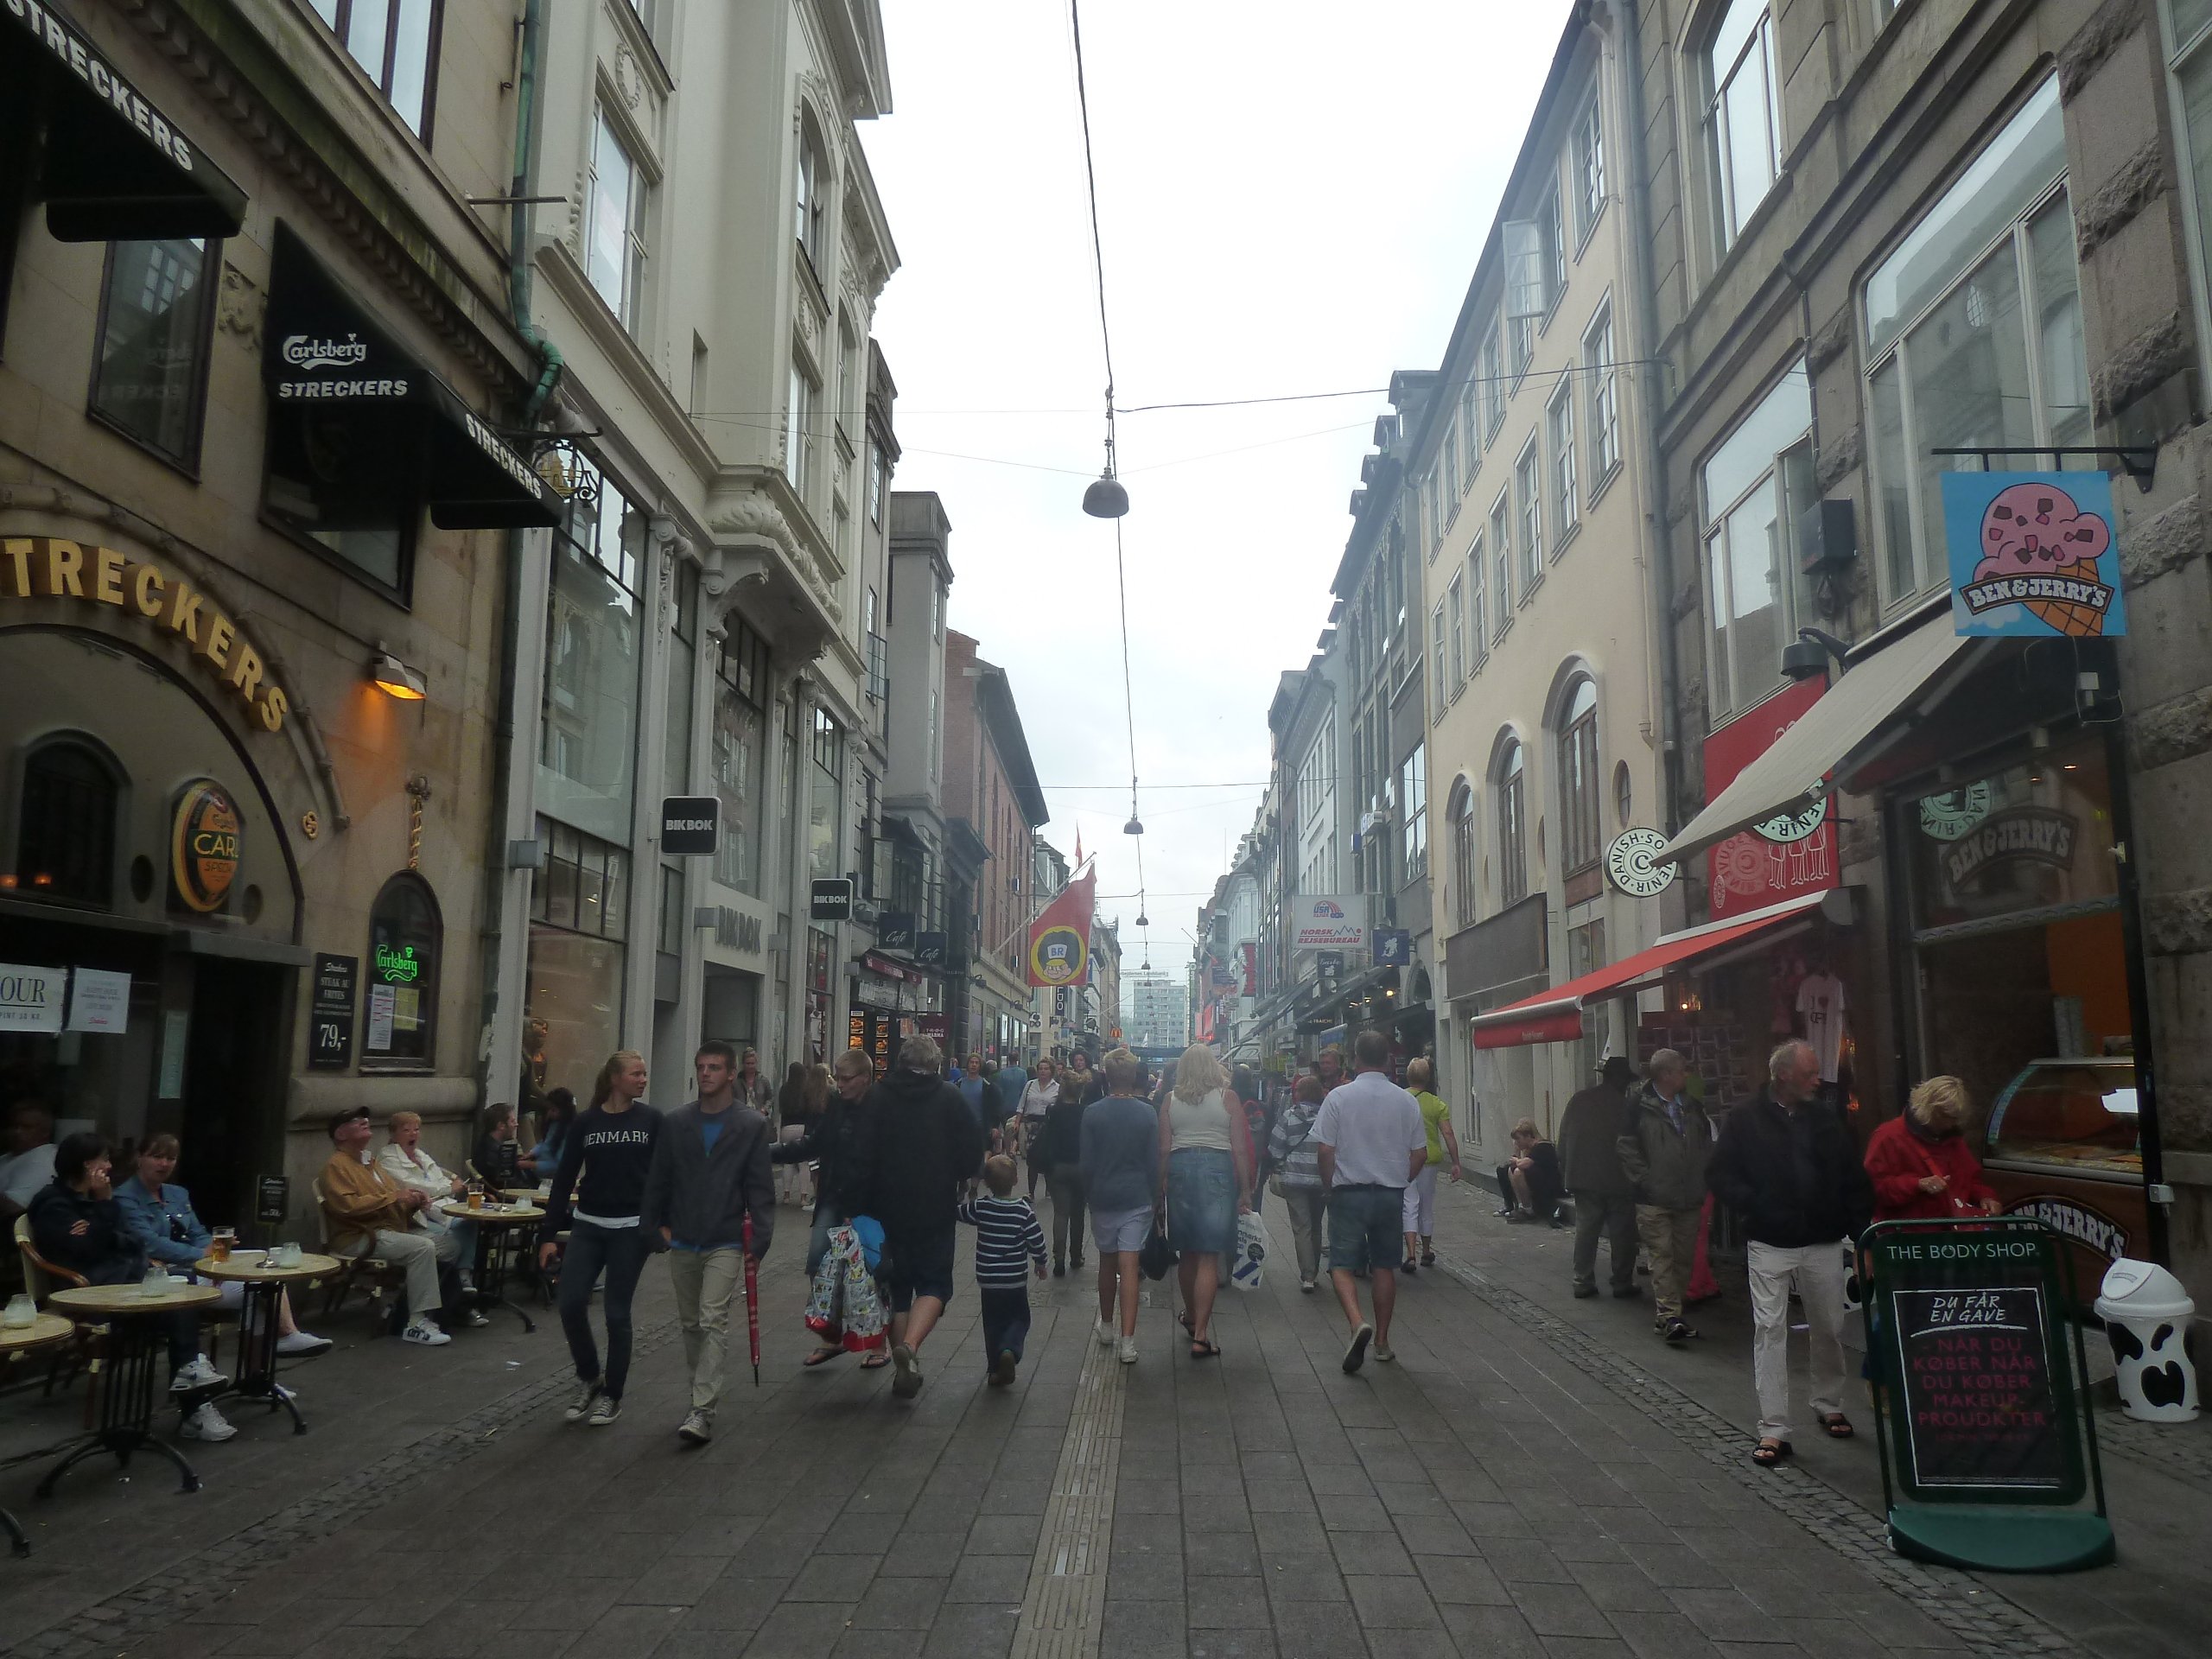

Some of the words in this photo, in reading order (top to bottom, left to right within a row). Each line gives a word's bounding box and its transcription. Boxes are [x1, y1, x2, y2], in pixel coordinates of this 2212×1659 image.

[283, 334, 366, 366] Carlsberg
[278, 379, 408, 397] STRECKERS
[465, 413, 542, 499] STRECKERS
[665, 820, 687, 831] BIK
[688, 820, 713, 831] BOK
[1611, 833, 1640, 886] DANISH
[1637, 833, 1674, 893] SOENIR
[813, 895, 829, 905] BIK
[830, 895, 848, 905] BOK
[1051, 947, 1065, 957] BR
[377, 944, 417, 977] Carlsberg
[1886, 1245, 1923, 1260] THE
[1929, 1243, 1981, 1259] BODY
[1986, 1243, 2037, 1258] SHOP
[1933, 1296, 1958, 1308] DU
[1965, 1292, 2001, 1308] FÅR
[1930, 1309, 1953, 1323] EN
[1958, 1309, 2005, 1323] GAVE
[1990, 1338, 2022, 1351] DU
[1922, 1375, 1952, 1389] DU
